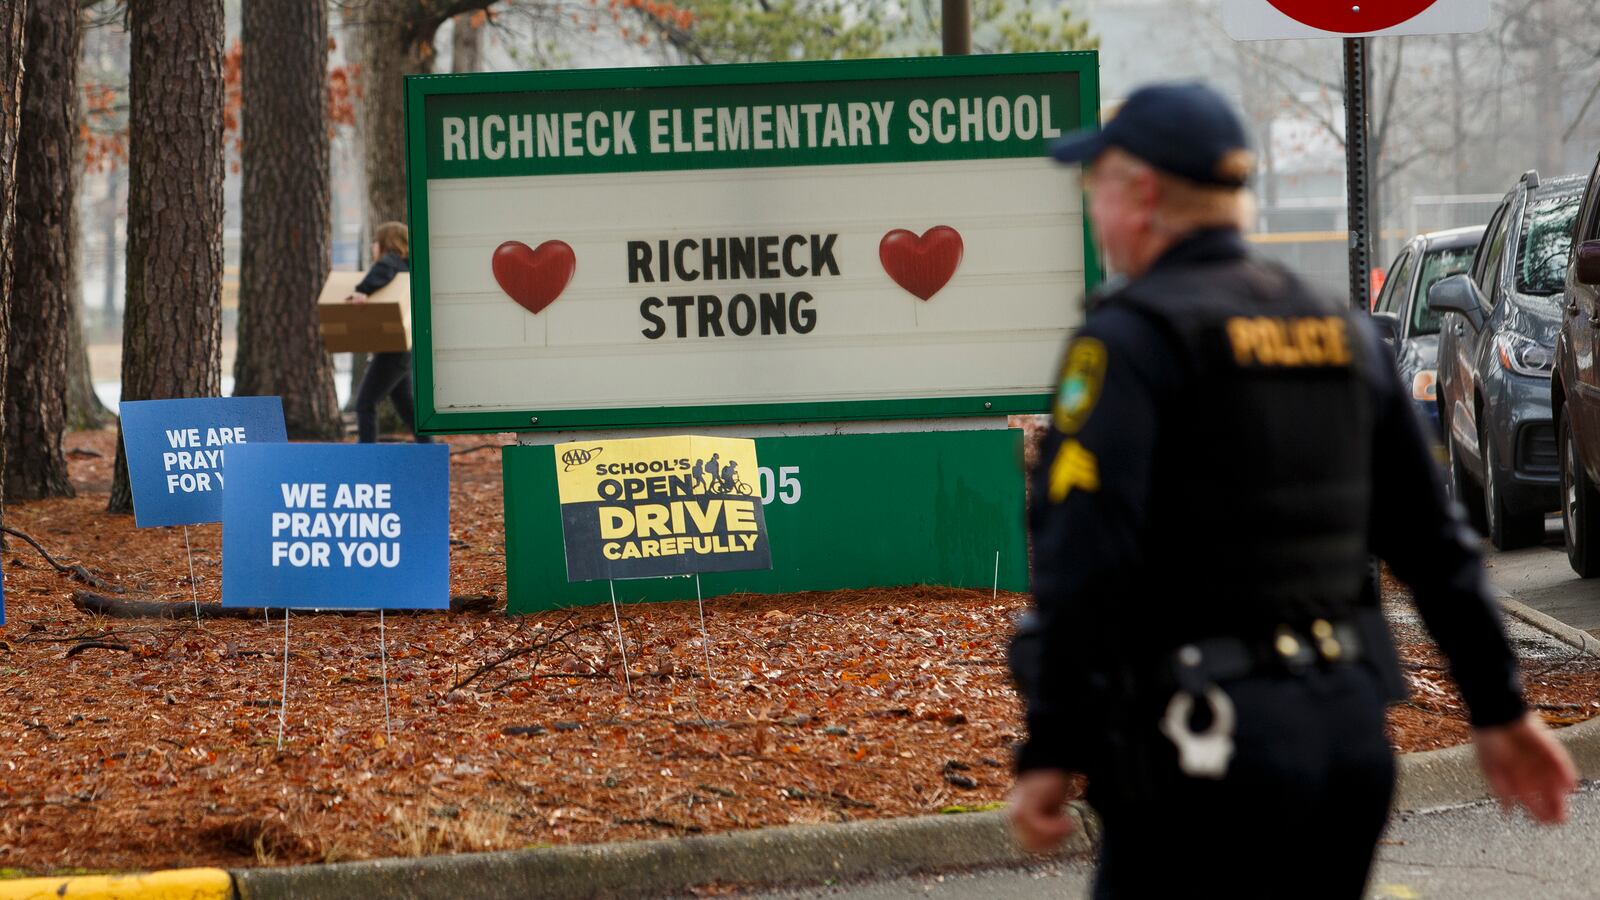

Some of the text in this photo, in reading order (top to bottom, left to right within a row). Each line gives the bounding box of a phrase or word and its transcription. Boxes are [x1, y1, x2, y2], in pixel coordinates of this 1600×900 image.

[442, 94, 1061, 161] RICHNECK ELEMENTARY SCHOOL
[627, 233, 840, 283] RICHNECK
[640, 291, 817, 339] STRONG
[1226, 316, 1351, 367] POLICE
[166, 427, 247, 448] WE ARE
[564, 449, 589, 465] AAA
[596, 458, 691, 476] SCHOOL'S
[167, 472, 212, 494] FOR
[281, 483, 391, 509] WE ARE
[597, 473, 693, 501] OPEN
[272, 512, 401, 538] PRAYING
[599, 500, 758, 540] DRIVE
[272, 542, 400, 568] FOR YOU
[603, 533, 759, 560] CAREFULLY
